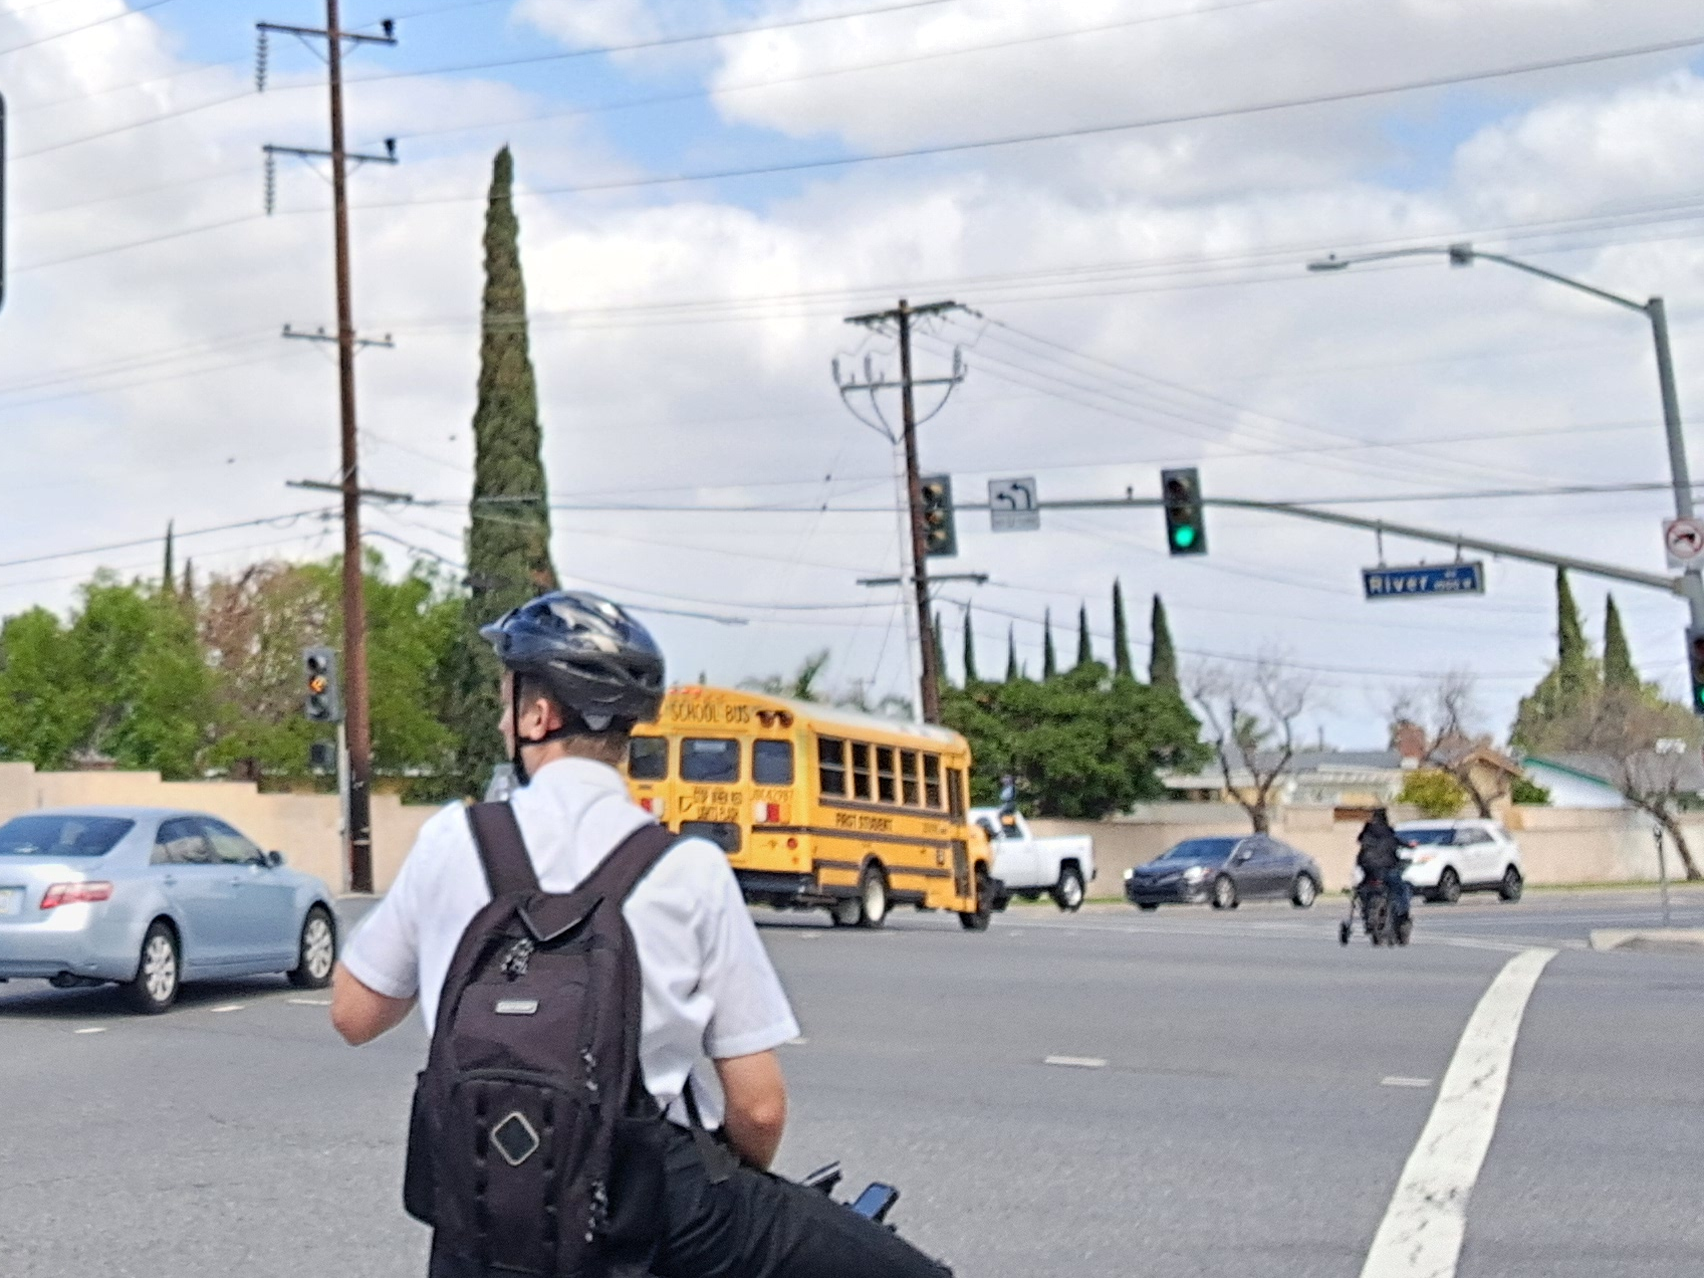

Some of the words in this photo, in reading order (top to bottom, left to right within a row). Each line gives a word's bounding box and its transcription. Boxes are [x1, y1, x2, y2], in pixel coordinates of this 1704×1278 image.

[1369, 574, 1429, 595] River
[671, 703, 720, 723] SCHOOL
[725, 704, 750, 724] BUS
